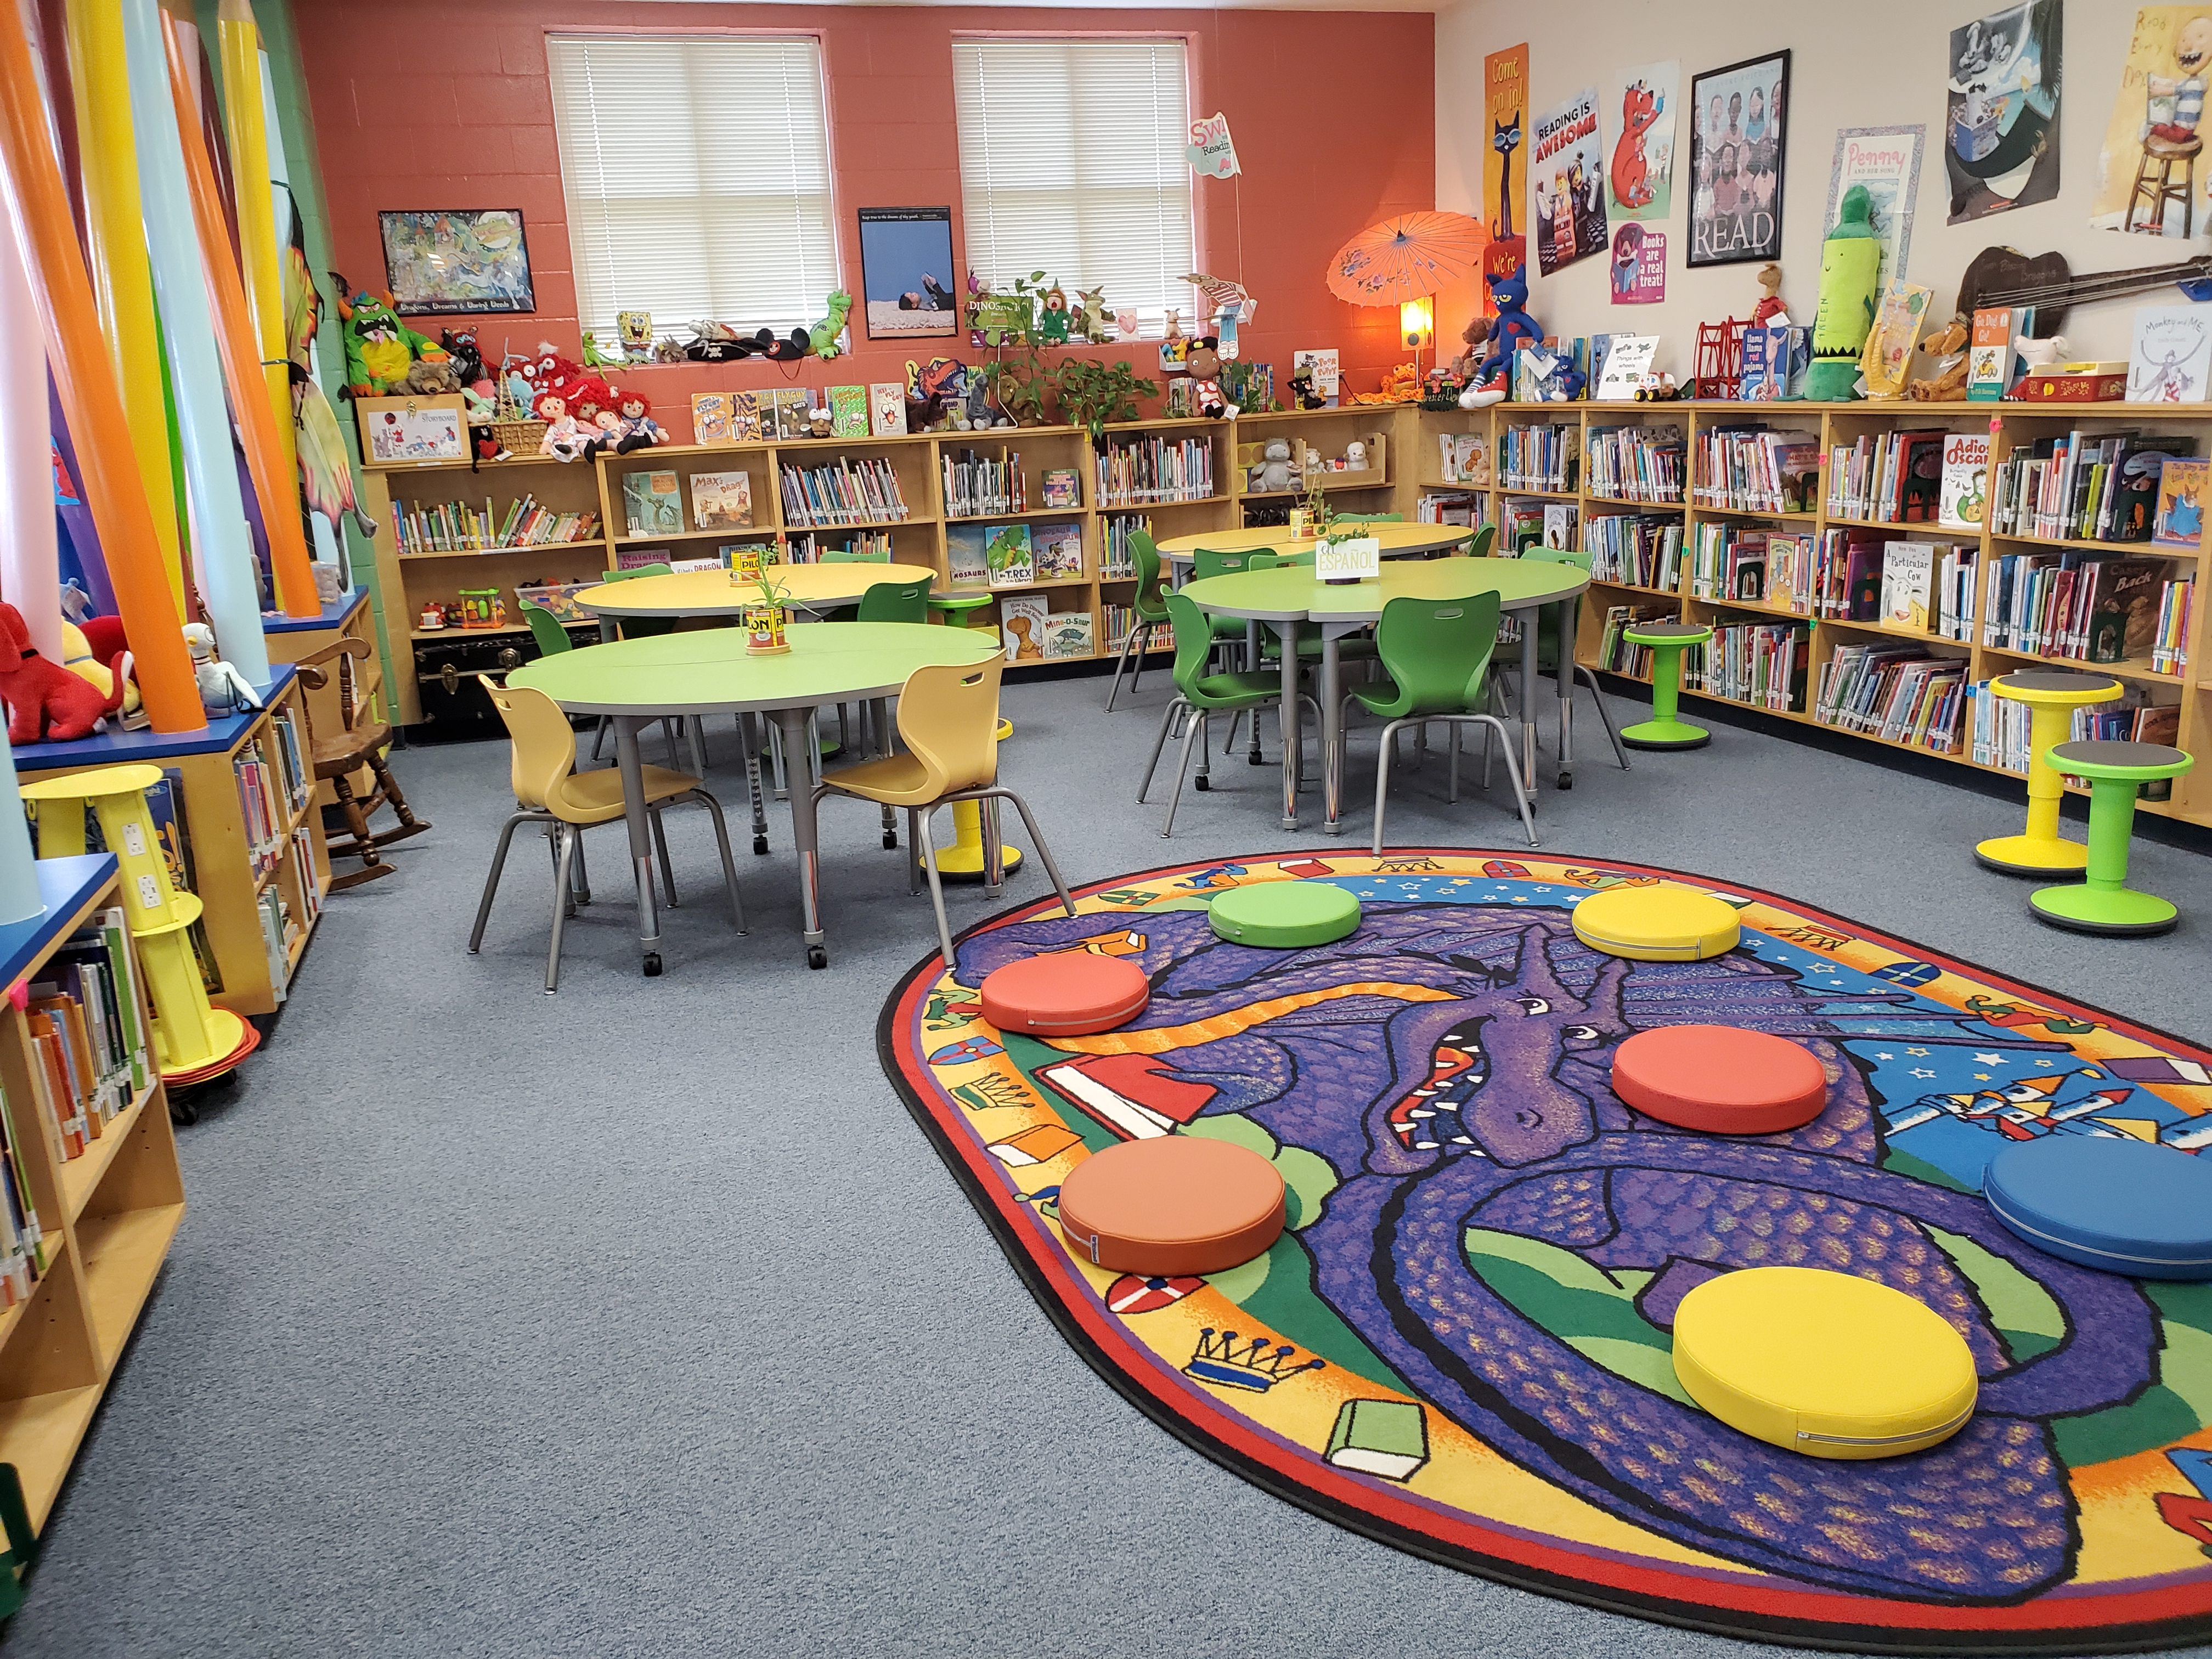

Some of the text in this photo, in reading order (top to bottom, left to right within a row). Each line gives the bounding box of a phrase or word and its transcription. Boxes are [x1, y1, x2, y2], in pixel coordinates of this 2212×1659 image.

[1492, 57, 1519, 83] Come
[1493, 77, 1523, 115] on in!
[1538, 101, 1590, 141] READING IS
[1536, 112, 1597, 163] AWESOME
[1847, 143, 1906, 176] Penny
[1642, 235, 1664, 249] Books
[1693, 212, 1775, 258] READ
[1493, 251, 1516, 274] We're
[1646, 250, 1659, 261] are
[1640, 260, 1664, 274] a real
[1640, 273, 1663, 287] treat!
[2146, 315, 2176, 334] Monkey
[1747, 334, 1763, 343] llama
[1747, 343, 1762, 352] llama
[1318, 358, 1336, 367] POOR
[1749, 352, 1759, 362] red
[1743, 362, 1764, 374] pajama
[791, 390, 805, 398] GUY
[693, 476, 724, 488] Max's
[1321, 545, 1336, 555] en
[1886, 549, 1891, 557] A
[622, 553, 666, 562] Raising
[1319, 549, 1375, 571] ESPAÑOL
[1891, 555, 1929, 569] Particular
[694, 562, 721, 572] DRAGON
[1908, 569, 1921, 581] Cow
[2113, 571, 2152, 593] Back
